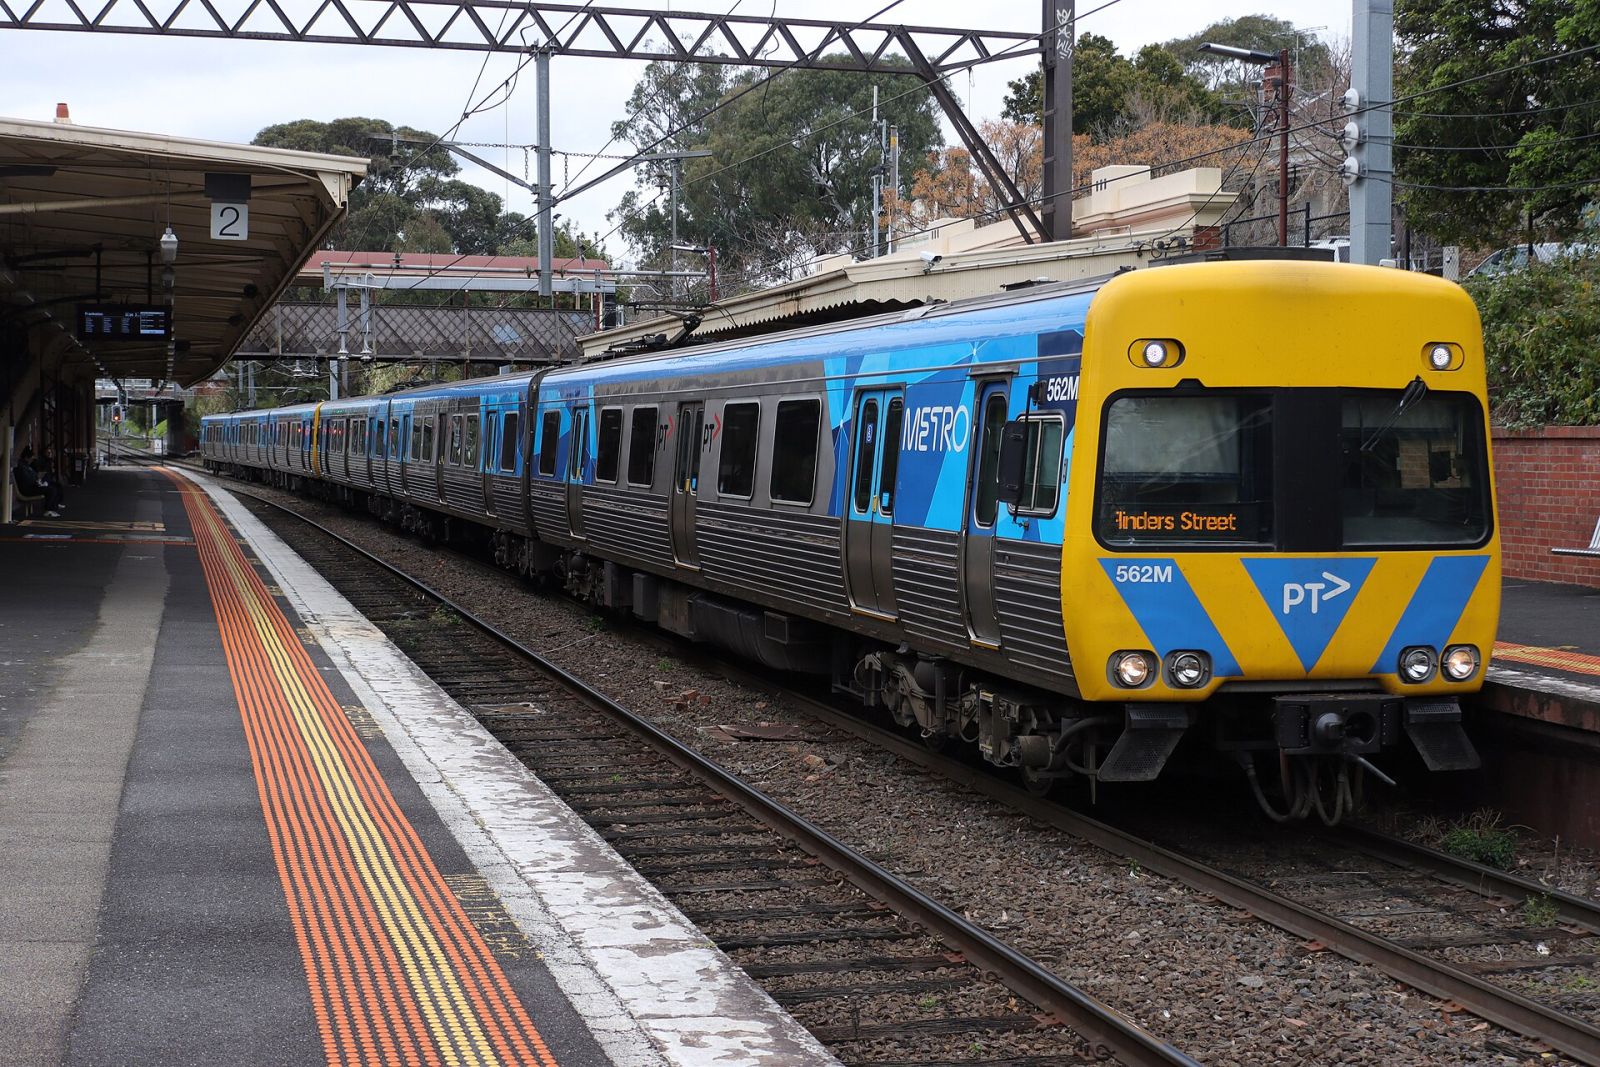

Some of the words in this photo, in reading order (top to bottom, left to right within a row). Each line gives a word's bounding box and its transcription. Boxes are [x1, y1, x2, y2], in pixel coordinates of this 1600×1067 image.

[219, 206, 240, 237] 2
[1046, 376, 1080, 402] 562M
[902, 405, 970, 453] METRO
[1180, 511, 1237, 531] Street
[1115, 565, 1172, 583] 562M
